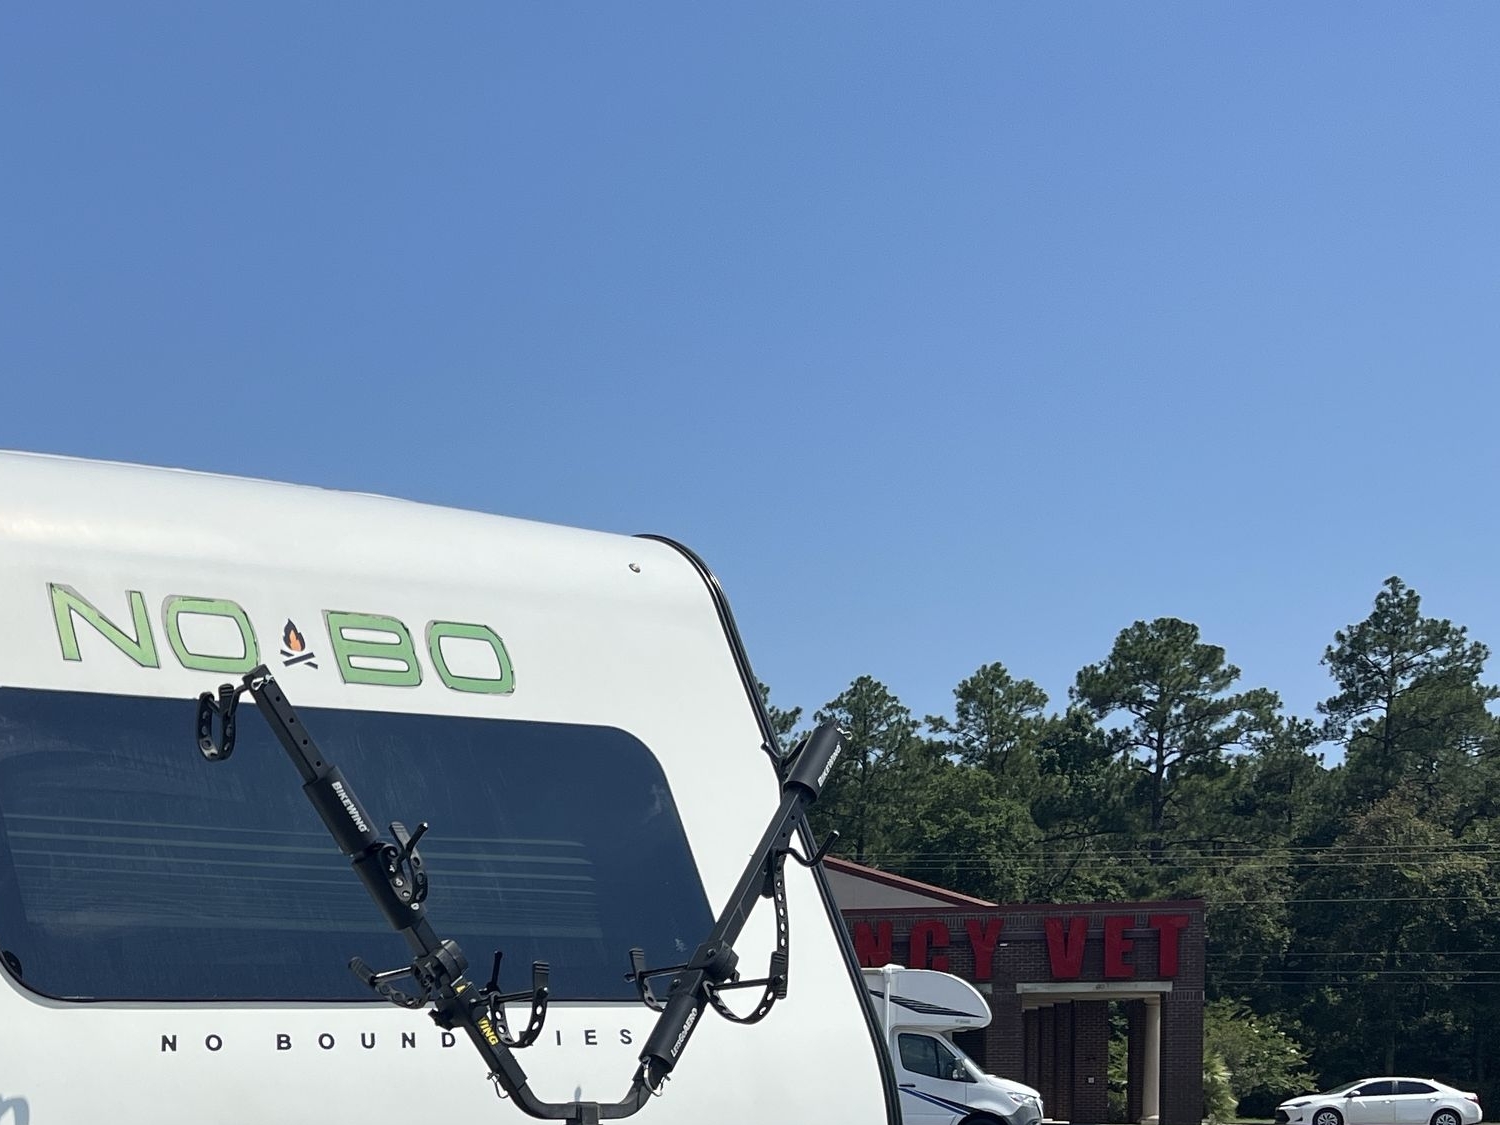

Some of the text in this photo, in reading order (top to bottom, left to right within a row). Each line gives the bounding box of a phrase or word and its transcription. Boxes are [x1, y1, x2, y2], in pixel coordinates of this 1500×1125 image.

[46, 582, 517, 696] NO BO
[331, 781, 368, 832] BIKEWING
[1044, 914, 1190, 979] VET
[161, 1029, 633, 1052] NO BOUNDIES
